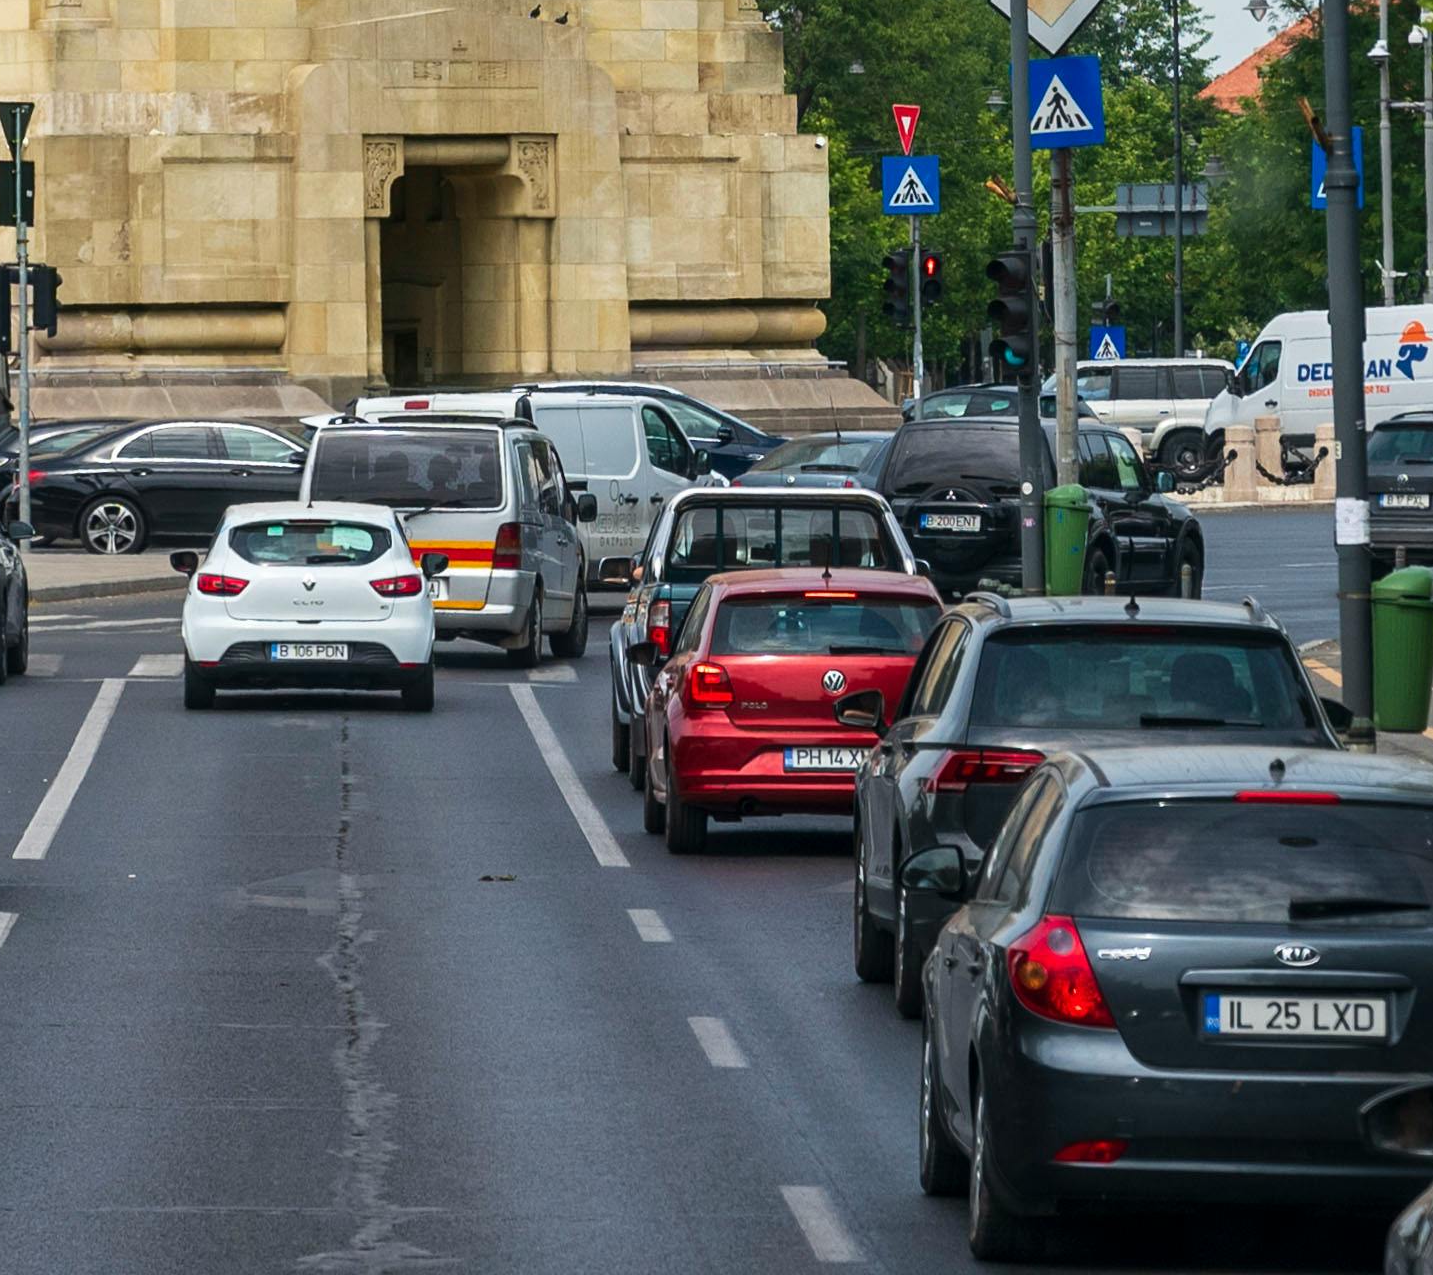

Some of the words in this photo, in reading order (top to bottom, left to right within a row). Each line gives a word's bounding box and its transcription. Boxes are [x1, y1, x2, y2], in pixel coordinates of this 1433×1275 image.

[279, 645, 288, 657] B
[316, 645, 345, 658] PDN
[797, 750, 821, 765] PH
[828, 750, 843, 764] 14
[1282, 947, 1311, 959] KIA
[1229, 1001, 1253, 1029] IL
[1266, 1002, 1301, 1029] 25
[1313, 1003, 1374, 1031] LXD
